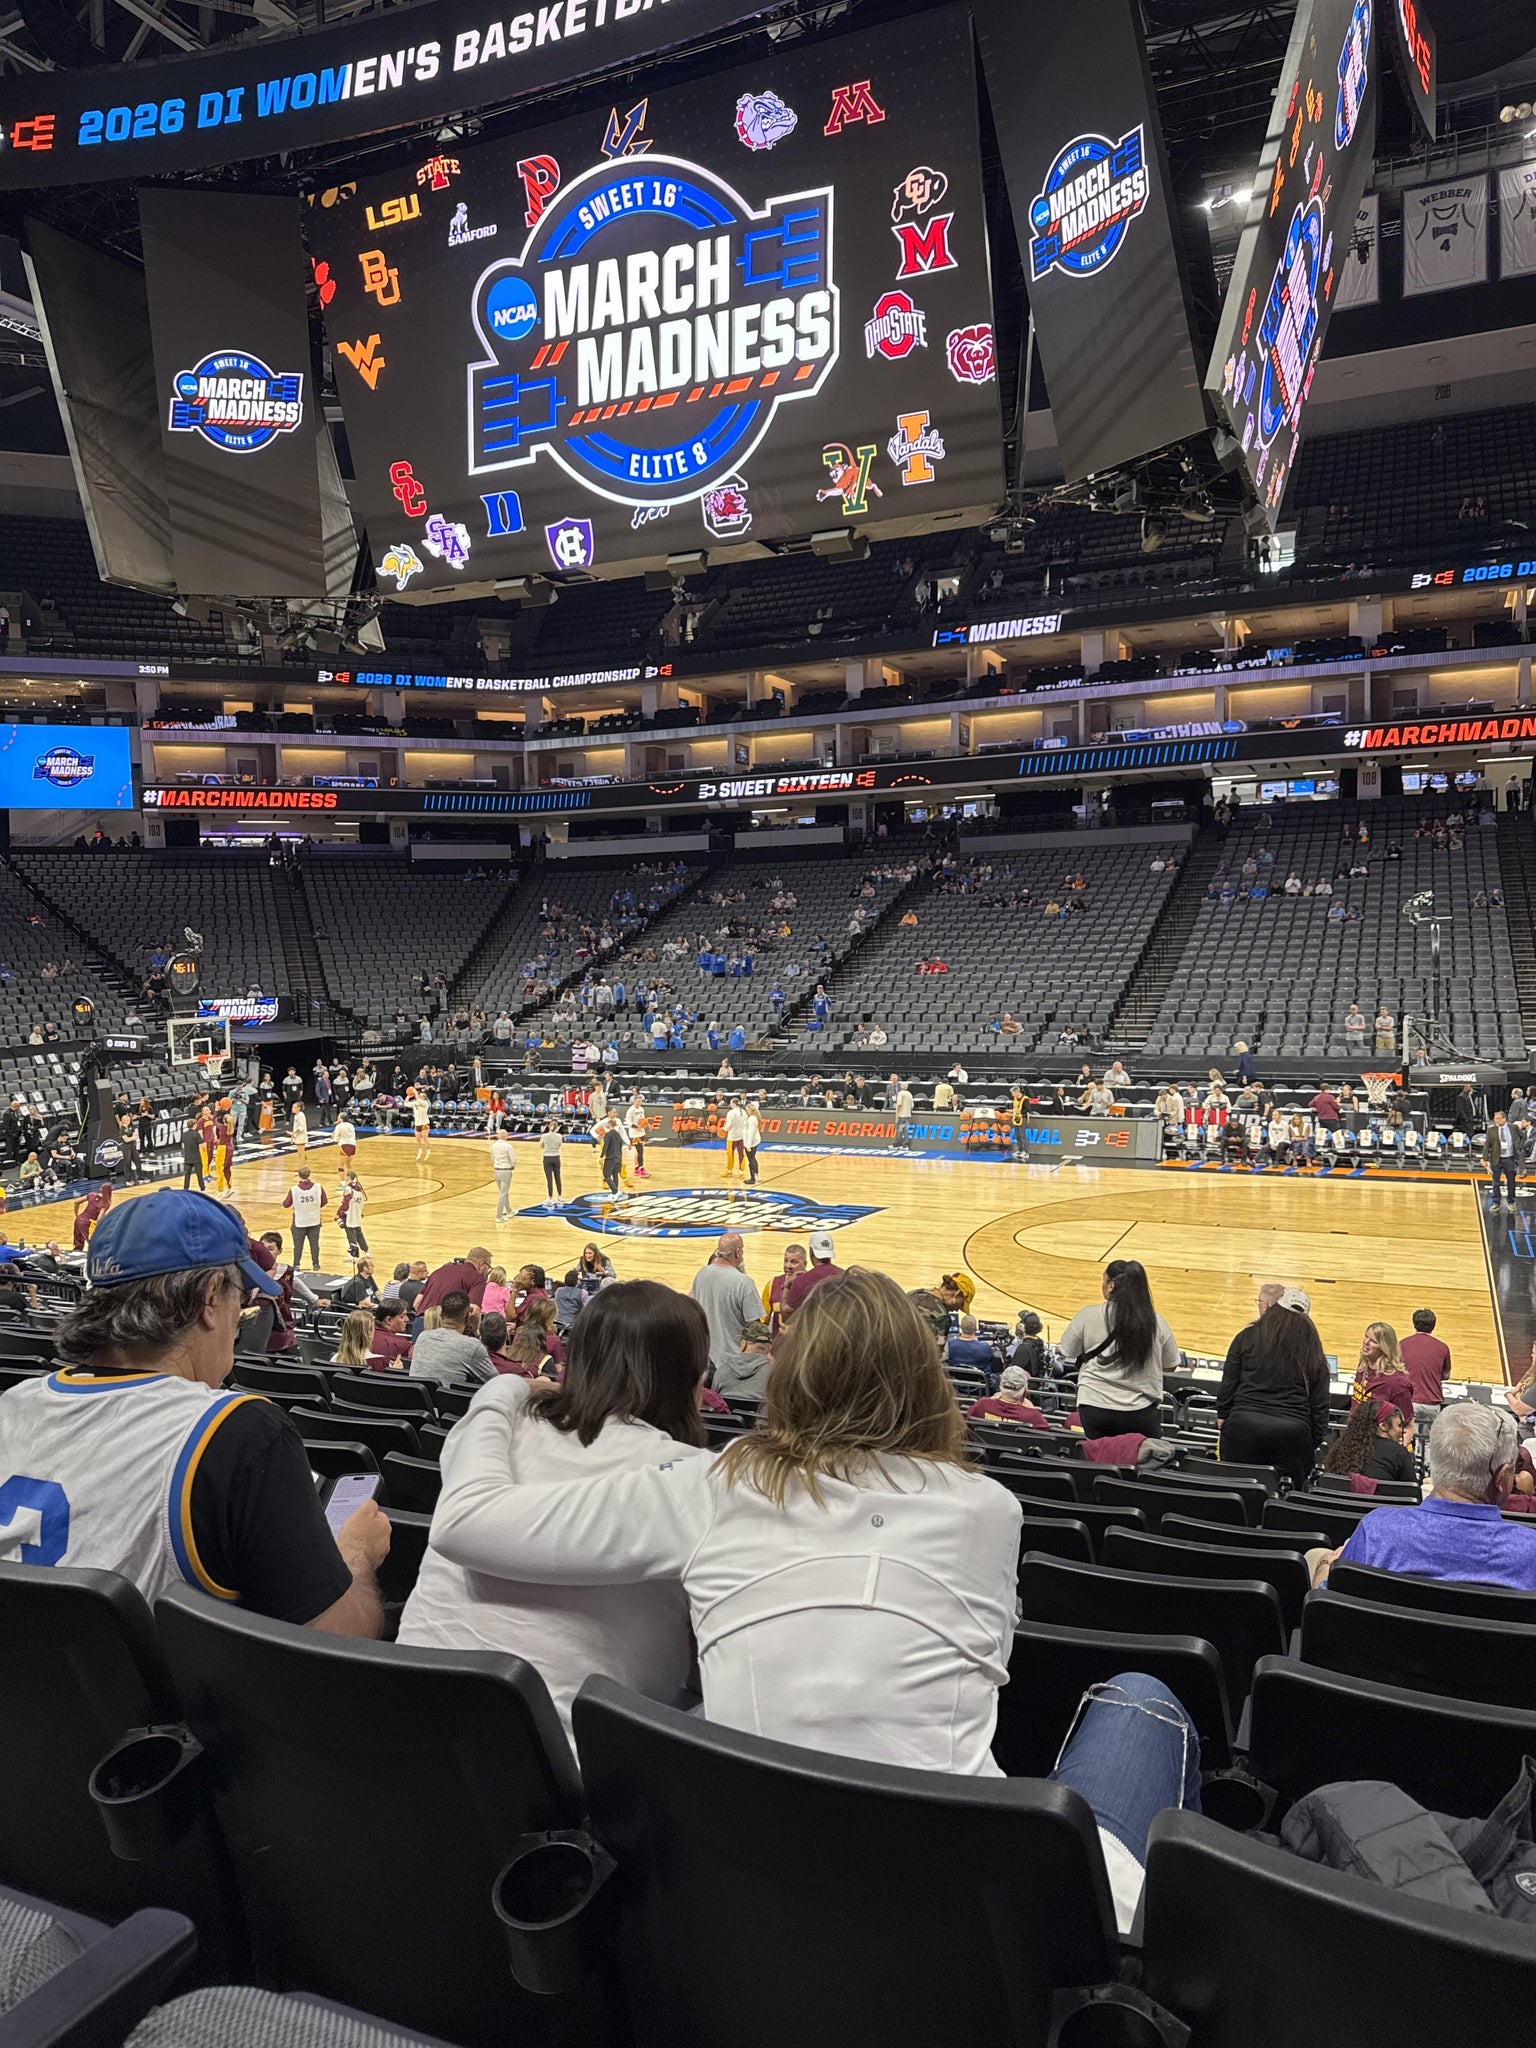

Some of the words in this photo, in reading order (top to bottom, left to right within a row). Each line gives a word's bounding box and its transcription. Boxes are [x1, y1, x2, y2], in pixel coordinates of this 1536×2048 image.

[78, 99, 184, 146] 2026
[197, 87, 243, 128] DI
[256, 41, 441, 117] WOMEN'S
[824, 80, 885, 136] M
[1058, 150, 1080, 175] SWEET
[1081, 145, 1090, 158] 16
[416, 158, 461, 187] STATE
[1050, 159, 1110, 222] MARCH
[1419, 188, 1472, 206] WEBBER
[365, 193, 420, 231] LSU
[577, 180, 645, 231] SWEET
[652, 183, 678, 208] 16
[1061, 169, 1145, 246] MADNESS
[448, 224, 498, 247] SAMFORD
[891, 212, 958, 281] M
[1440, 239, 1450, 252] 4
[1080, 252, 1101, 267] ELITE
[358, 249, 400, 306] BU
[543, 235, 731, 340] MARCH
[493, 303, 538, 328] NCAA
[576, 290, 832, 406] MADNESS
[213, 358, 238, 370] SWEET
[198, 377, 266, 400] MARCH
[208, 399, 299, 422] MADNESS
[224, 434, 247, 446] ELITE
[888, 429, 946, 466] Vandals
[629, 449, 687, 479] ELITE
[480, 490, 525, 537] D
[1463, 564, 1513, 582] 2026
[968, 614, 1058, 642] MADNESS
[139, 665, 156, 674] 3:50
[157, 666, 169, 674] PM
[356, 672, 392, 685] 2026
[395, 674, 412, 686] DI
[414, 675, 474, 689] WOMEN'S
[476, 678, 551, 691] BASKETBALL
[552, 667, 641, 688] CHAMPIONSHIP
[46, 756, 79, 766] MARCH
[50, 766, 94, 775] MADNESS
[719, 778, 777, 798] SWEET
[776, 772, 854, 794] SIXTEEN
[1362, 771, 1377, 786] 108
[142, 789, 338, 808] #MARCHMADNESS
[219, 1004, 276, 1017] MADNESS
[1439, 1073, 1477, 1083] SPALDING
[759, 1119, 783, 1134] TO
[786, 1119, 818, 1135] THE
[624, 1195, 793, 1214] MARCH
[613, 1206, 852, 1232] MADNESS
